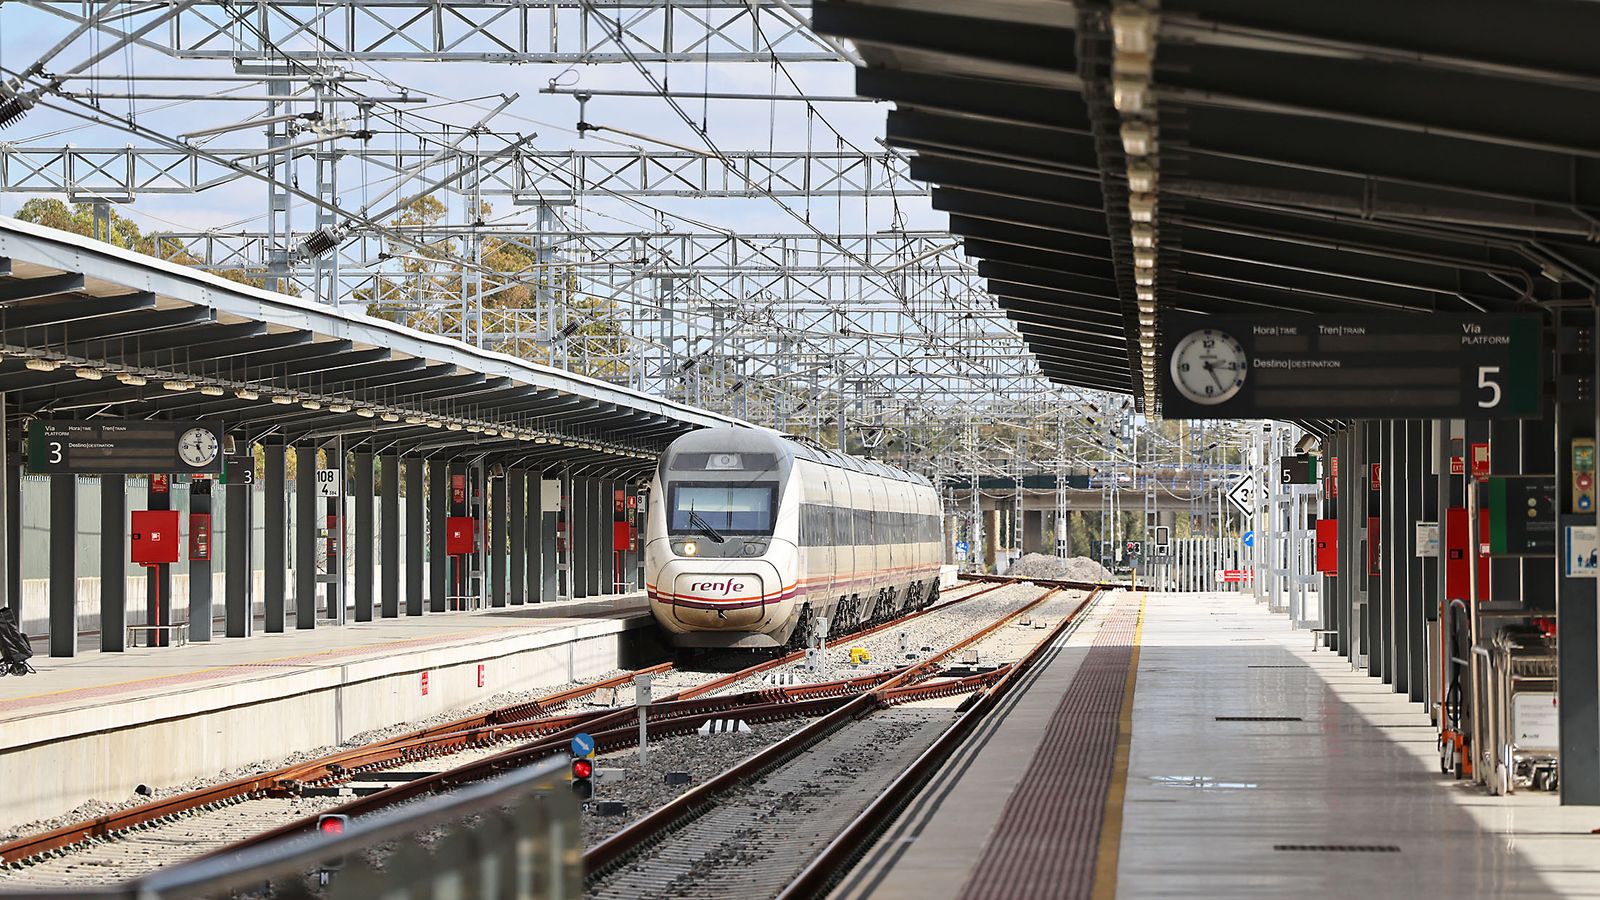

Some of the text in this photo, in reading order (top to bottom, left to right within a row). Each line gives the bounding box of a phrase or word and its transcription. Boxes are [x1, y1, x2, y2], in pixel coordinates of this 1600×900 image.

[1461, 336, 1510, 344] PLATFORM
[1478, 366, 1501, 408] 5
[49, 441, 62, 464] 3
[243, 470, 252, 484] 3
[316, 470, 334, 483] 108
[1282, 469, 1292, 483] 5
[321, 483, 329, 496] 4
[690, 577, 745, 597] renfe
